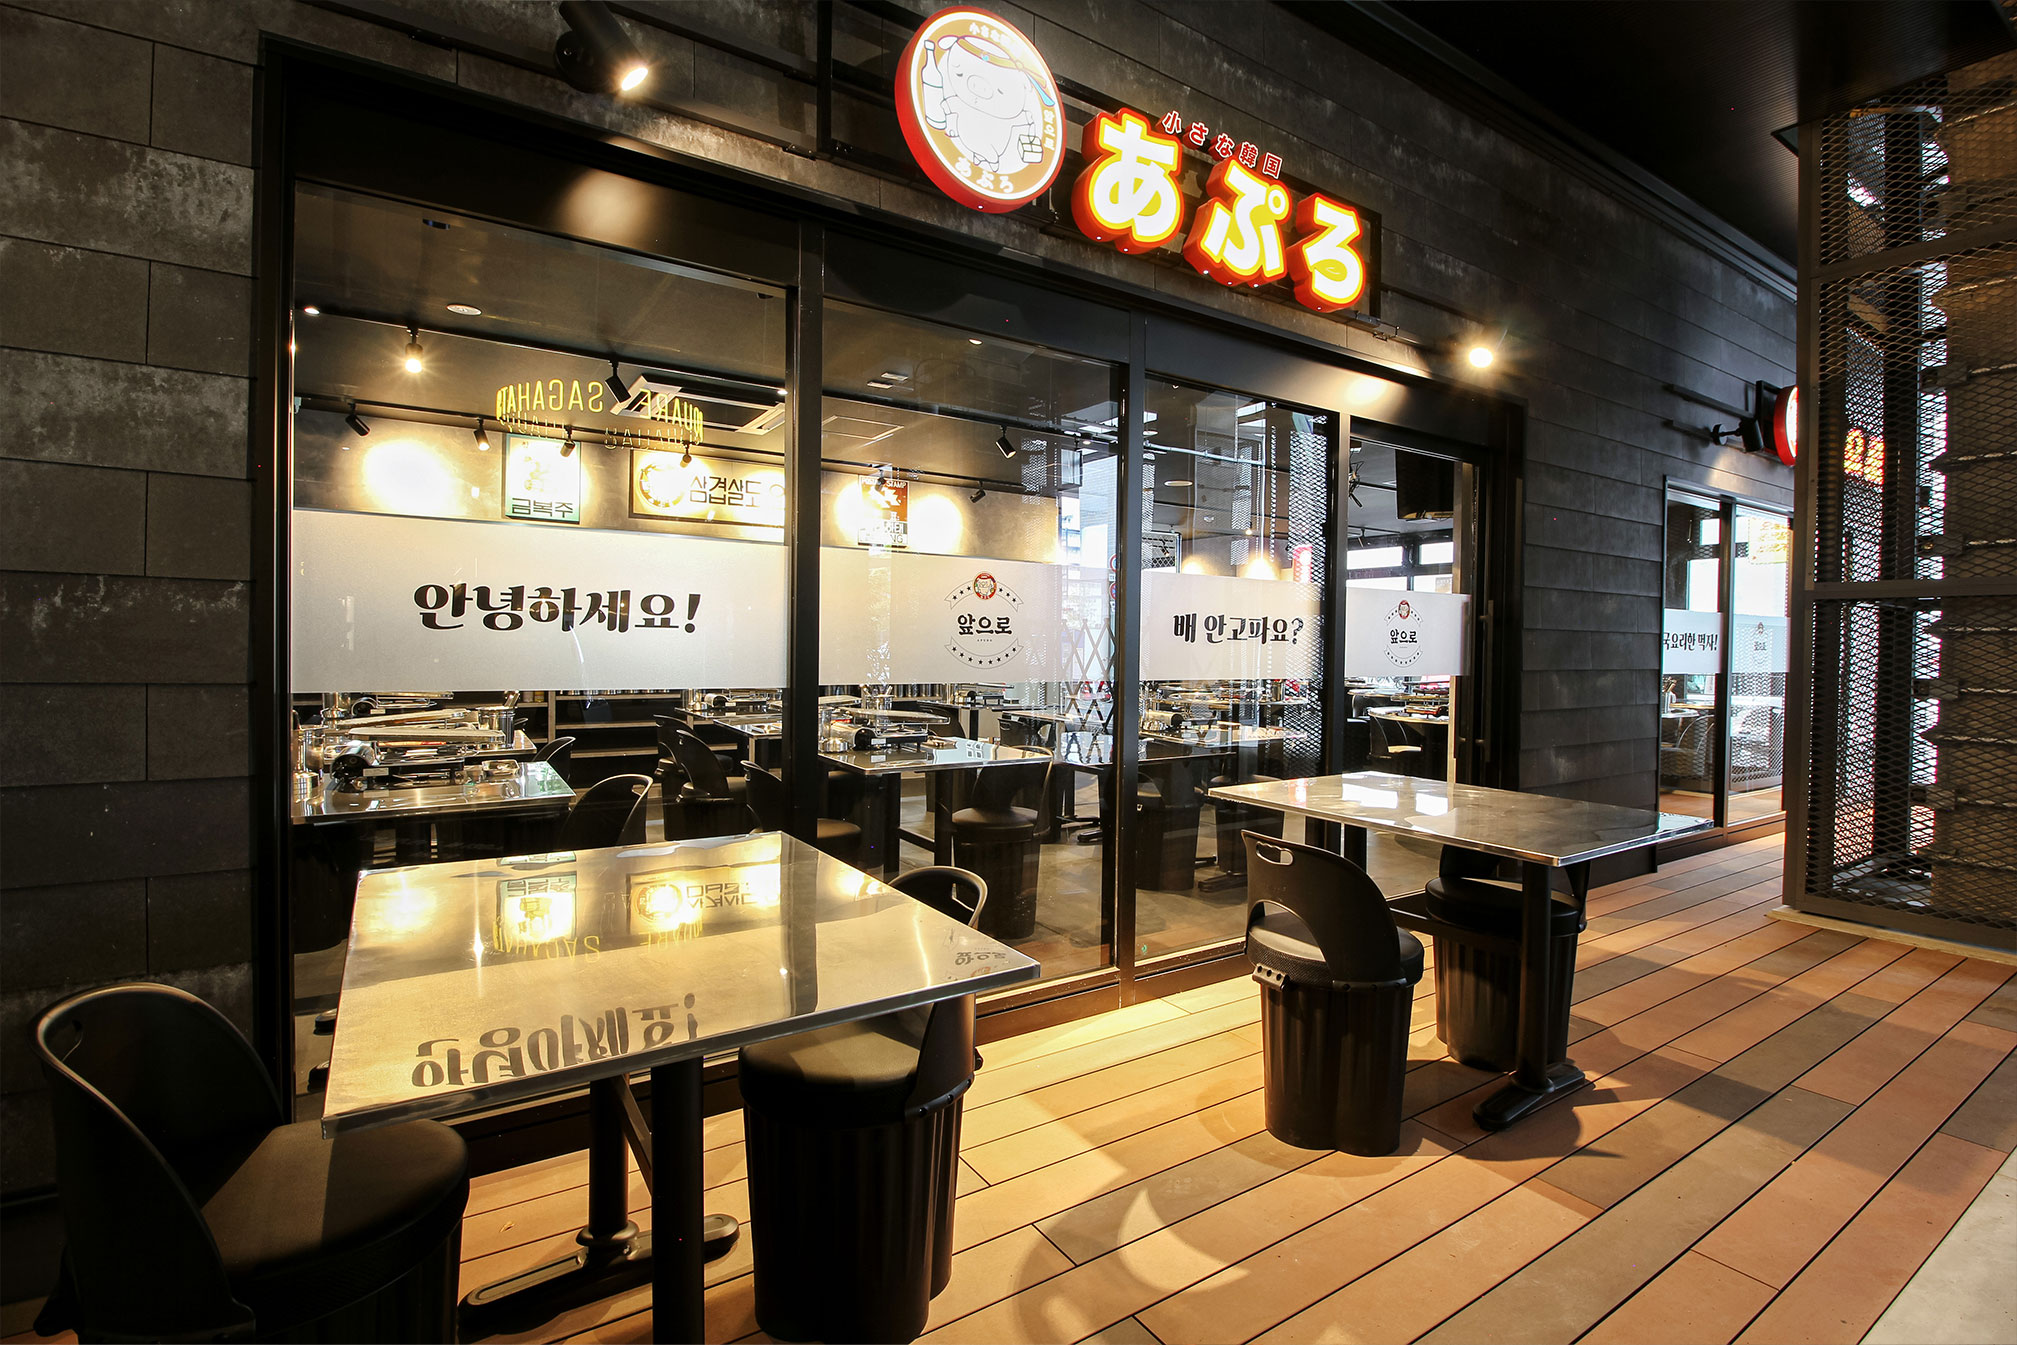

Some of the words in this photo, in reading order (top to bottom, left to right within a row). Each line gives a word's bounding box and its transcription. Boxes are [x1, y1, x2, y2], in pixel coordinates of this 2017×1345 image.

[1162, 110, 1283, 179] 小さな韓国
[1086, 110, 1366, 308] あぷろ
[511, 497, 574, 518] 금복주
[413, 581, 702, 634] 안녕하세요!
[957, 613, 1013, 636] 앞으로
[1173, 613, 1197, 643] 배
[1203, 614, 1304, 645] 안고파요?
[1389, 628, 1418, 644] 앞으로
